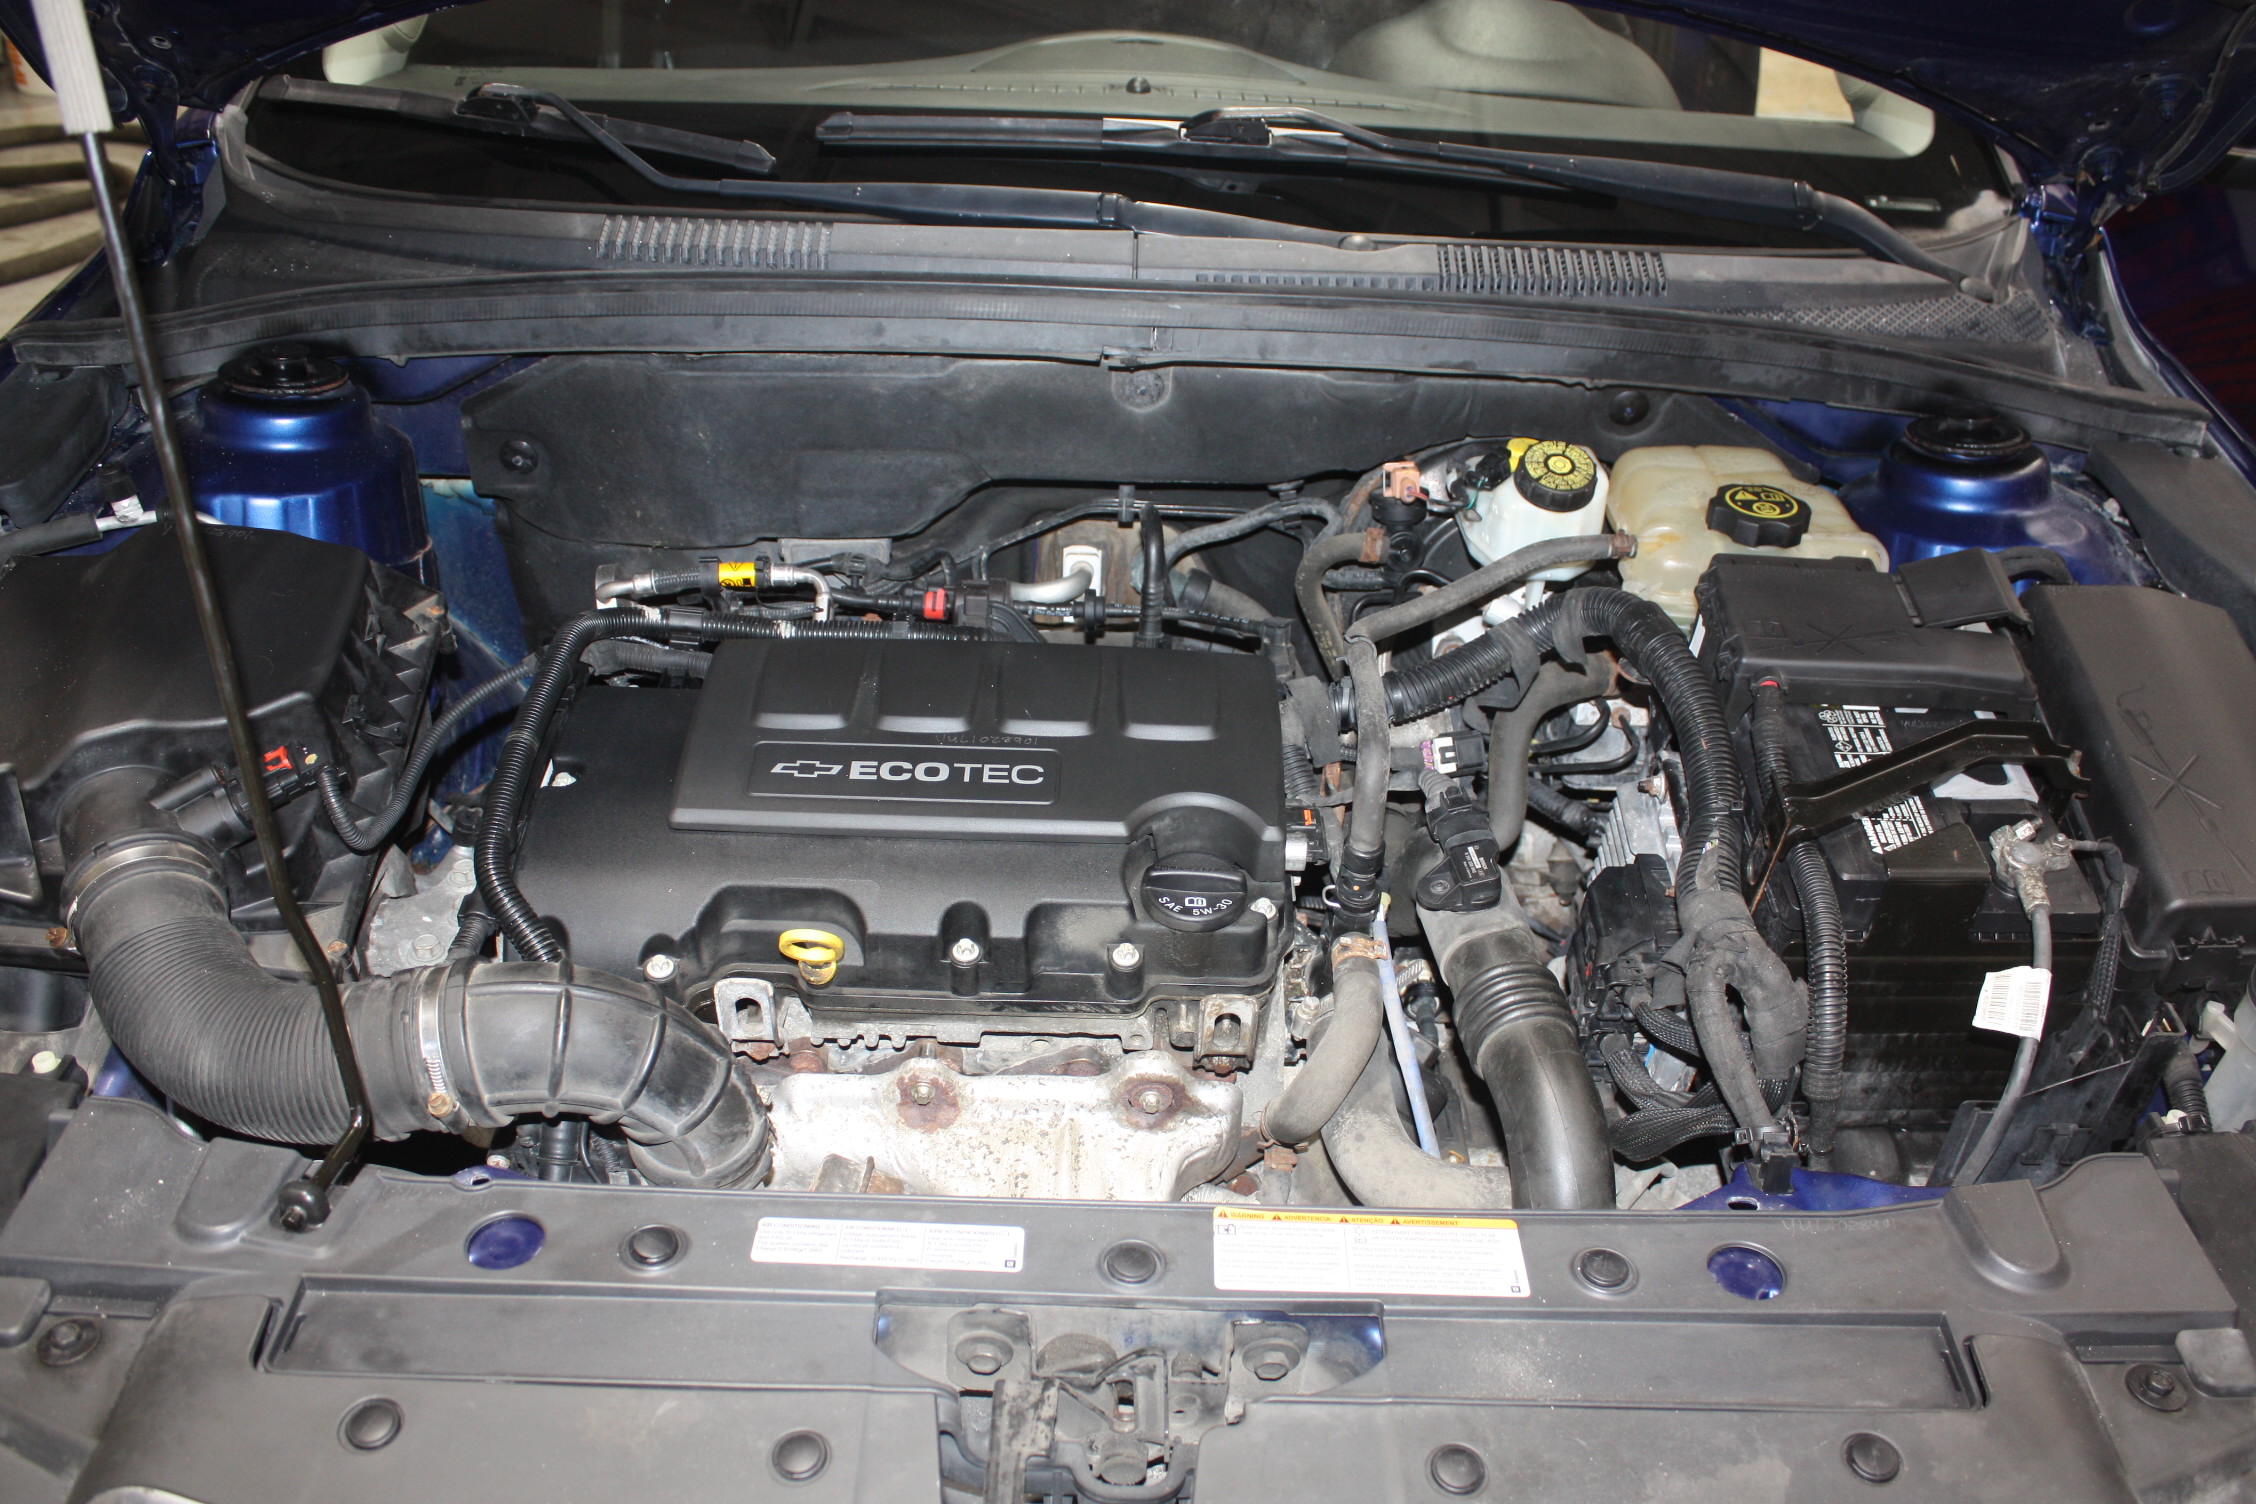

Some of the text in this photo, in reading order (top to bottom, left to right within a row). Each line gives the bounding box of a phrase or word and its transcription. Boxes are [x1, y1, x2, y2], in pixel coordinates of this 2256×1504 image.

[849, 760, 1045, 785] ECOTEC
[1158, 896, 1233, 916] SAE 5W-30
[1230, 1211, 1265, 1220] WARNING
